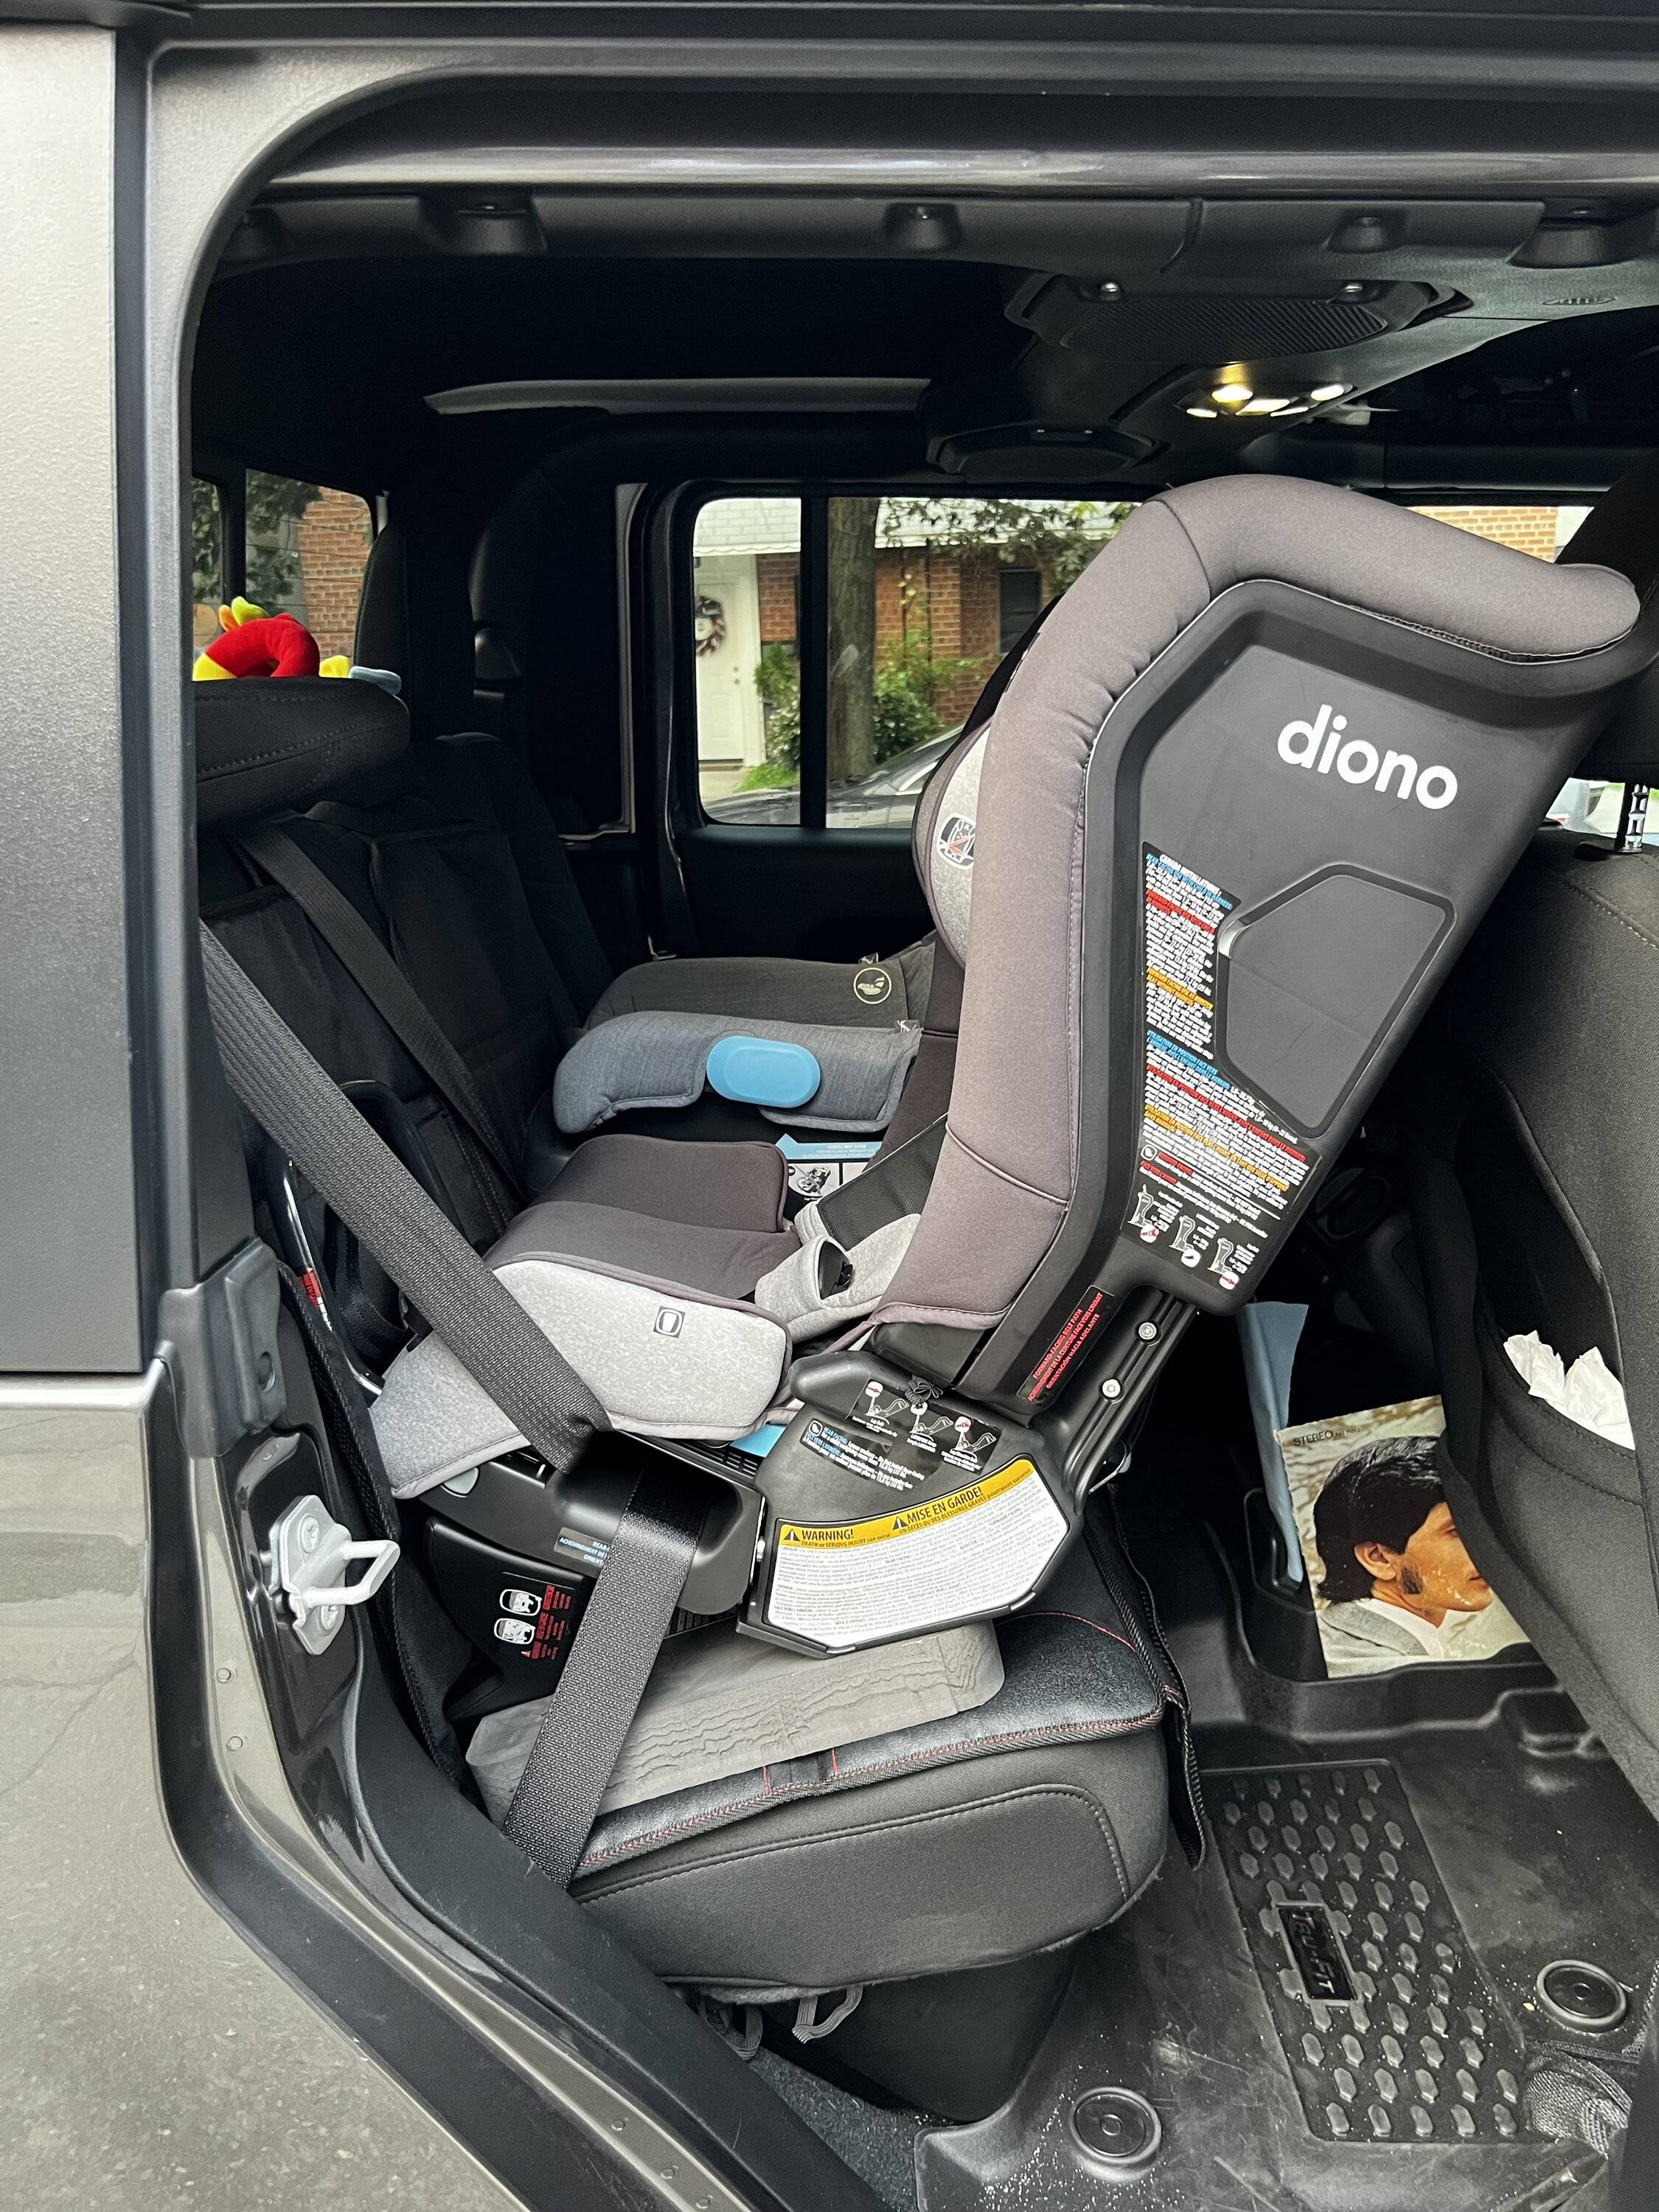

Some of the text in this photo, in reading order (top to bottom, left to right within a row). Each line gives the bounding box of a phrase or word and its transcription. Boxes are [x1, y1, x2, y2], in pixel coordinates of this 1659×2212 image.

[1277, 704, 1458, 810] diono
[1063, 1323, 1073, 1335] BELT
[1071, 1310, 1082, 1323] PATH
[1069, 1340, 1082, 1356] HACIA
[1080, 1314, 1099, 1340] ADELANTE
[1074, 1323, 1083, 1334] FACE
[1082, 1312, 1091, 1323] VERS
[1293, 1430, 1333, 1447] STEREO
[898, 1525, 908, 1534] UN
[922, 1519, 931, 1528] OU
[931, 1515, 941, 1526] DES
[941, 1503, 968, 1522] BLESSURES
[967, 1495, 988, 1509] GRAVES
[907, 1486, 984, 1524] MISE EN GARDE!
[801, 1528, 854, 1541] WARNING!
[848, 1538, 866, 1547] INJURY
